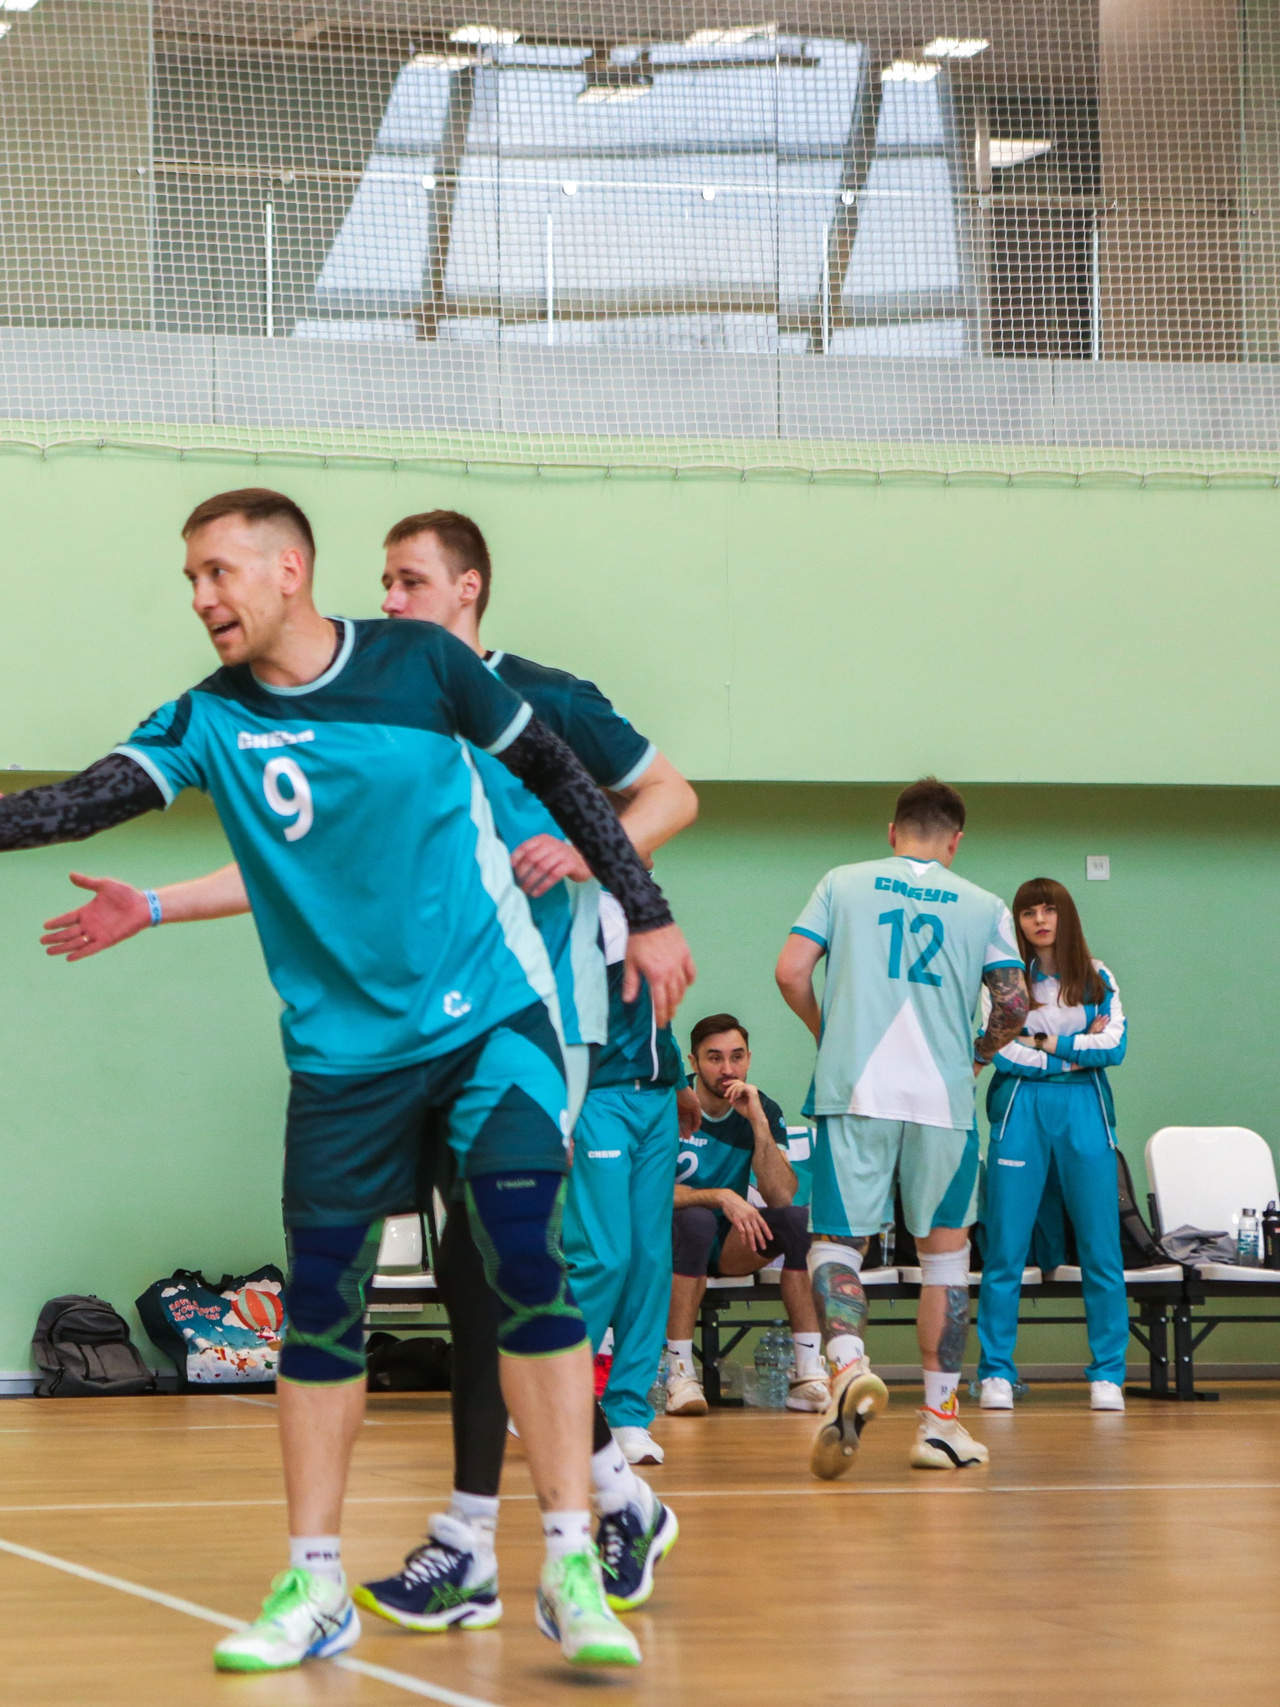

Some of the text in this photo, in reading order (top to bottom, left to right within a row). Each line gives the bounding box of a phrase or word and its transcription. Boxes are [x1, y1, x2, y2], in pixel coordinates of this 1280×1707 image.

[263, 756, 314, 842] 9
[874, 876, 959, 904] СИБУР
[878, 908, 945, 988] 12
